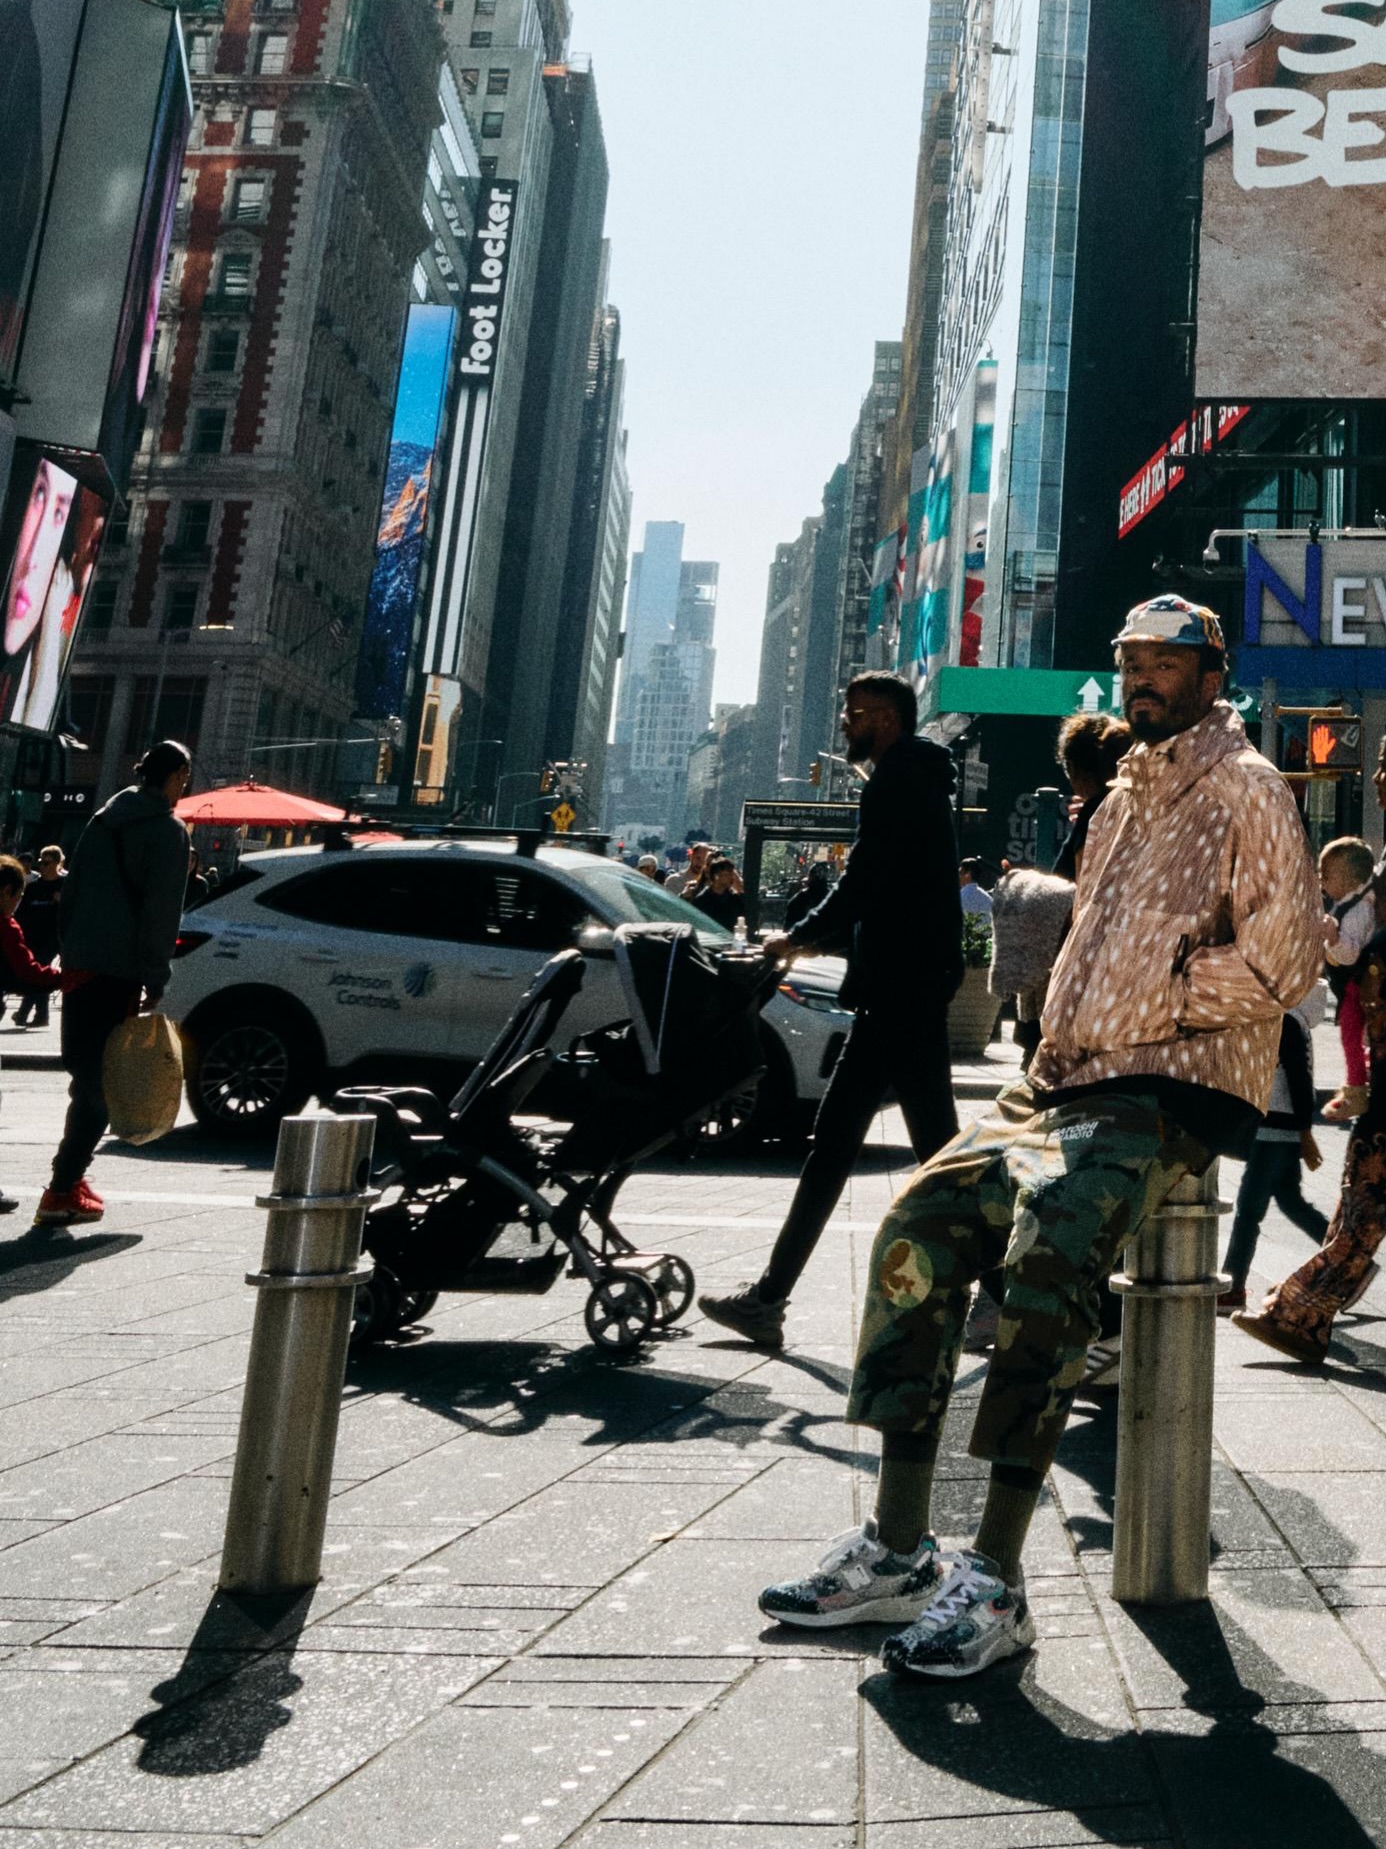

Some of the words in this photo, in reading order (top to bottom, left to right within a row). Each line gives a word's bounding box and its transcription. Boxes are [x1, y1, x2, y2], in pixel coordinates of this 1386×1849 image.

[460, 305, 498, 374] Foot
[746, 806, 774, 814] Times
[745, 817, 780, 826] Subway
[782, 817, 815, 826] Station
[328, 970, 393, 989] Johnson
[337, 989, 401, 1010] Controls
